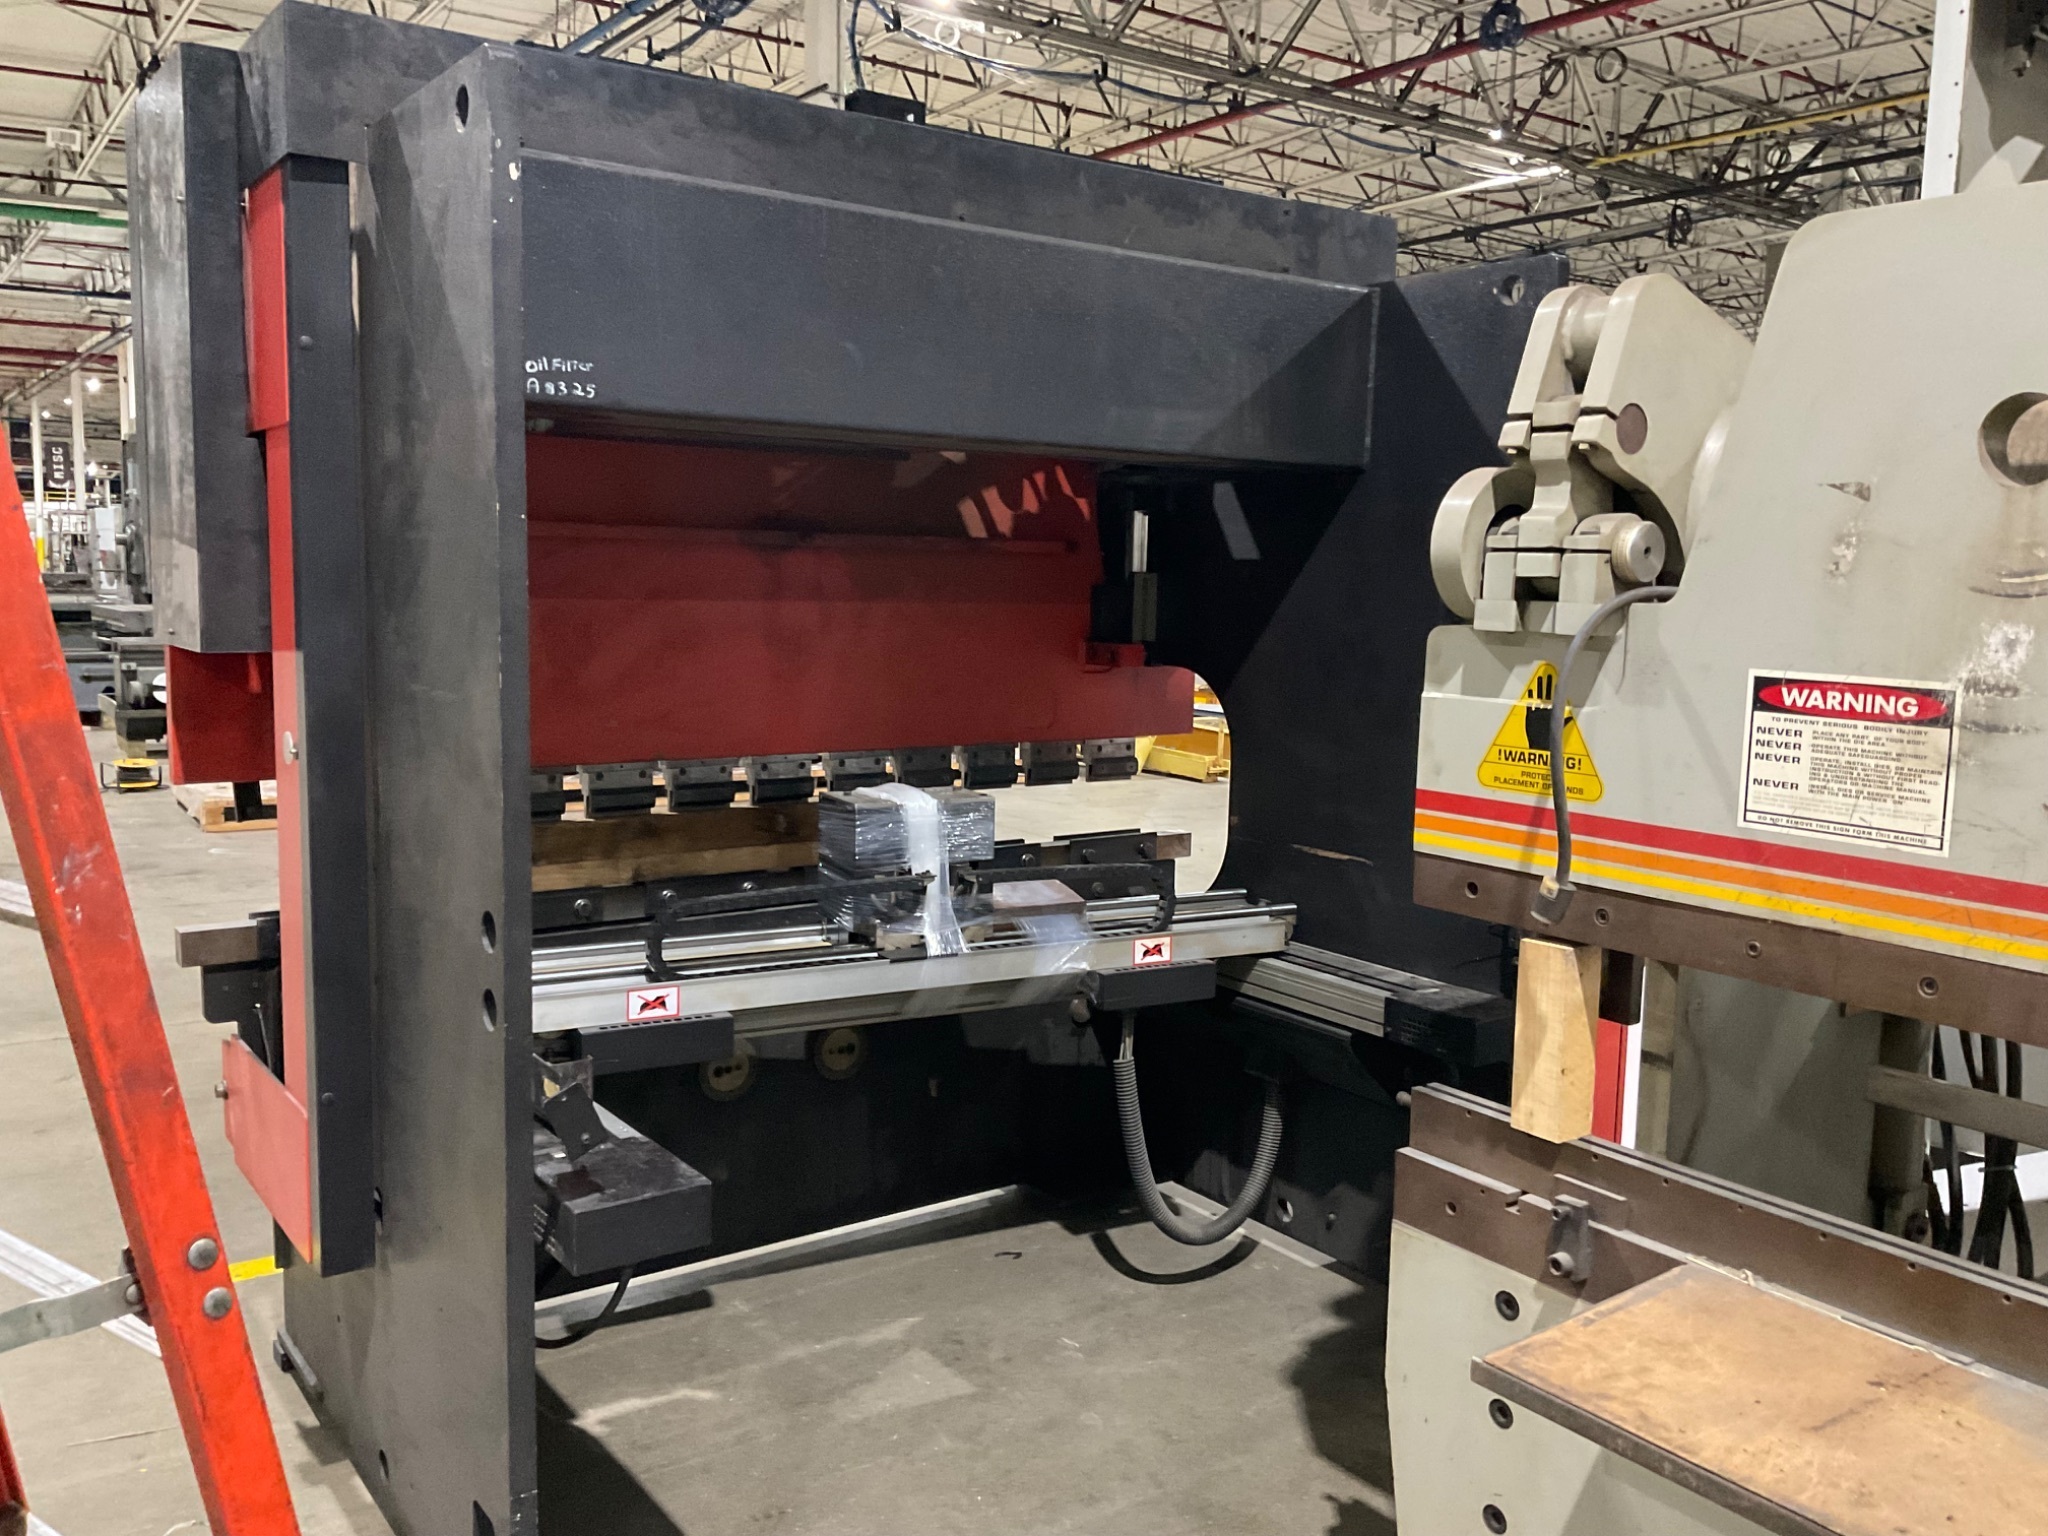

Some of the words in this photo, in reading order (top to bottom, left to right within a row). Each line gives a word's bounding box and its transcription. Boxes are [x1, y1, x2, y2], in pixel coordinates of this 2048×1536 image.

[525, 356, 549, 373] Oil
[552, 358, 594, 372] Filter
[1781, 687, 1919, 717] WARNING
[1757, 726, 1802, 738] NEVER
[1784, 718, 1820, 726] PREVENT
[1823, 721, 1858, 729] SERIOUS
[1863, 725, 1893, 733] BODILY
[1896, 728, 1928, 736] INJURY
[1756, 739, 1801, 751] NEVER
[1811, 743, 1841, 751] OPERATE
[1861, 748, 1893, 756] MACHINE
[1896, 752, 1928, 760] WITHOUT
[1811, 749, 1846, 757] ADEQUATE
[1498, 749, 1581, 771] !WARNG!
[1755, 752, 1800, 764] NEVER
[1907, 767, 1943, 776] MAINTAIN
[1521, 771, 1551, 781] PROTEC
[1809, 766, 1854, 776] INSTRUCTION
[1830, 774, 1889, 785] UNDERSTANDING
[1494, 776, 1539, 788] PLACEMENT
[1809, 776, 1848, 786] OPERATORS
[1862, 782, 1893, 791] MACHINE
[1753, 778, 1799, 791] NEVER
[1867, 791, 1895, 799] SERVICE
[1898, 795, 1931, 804] MACHINE
[1786, 819, 1813, 828] REMOVE
[1893, 835, 1927, 844] MACHINE
